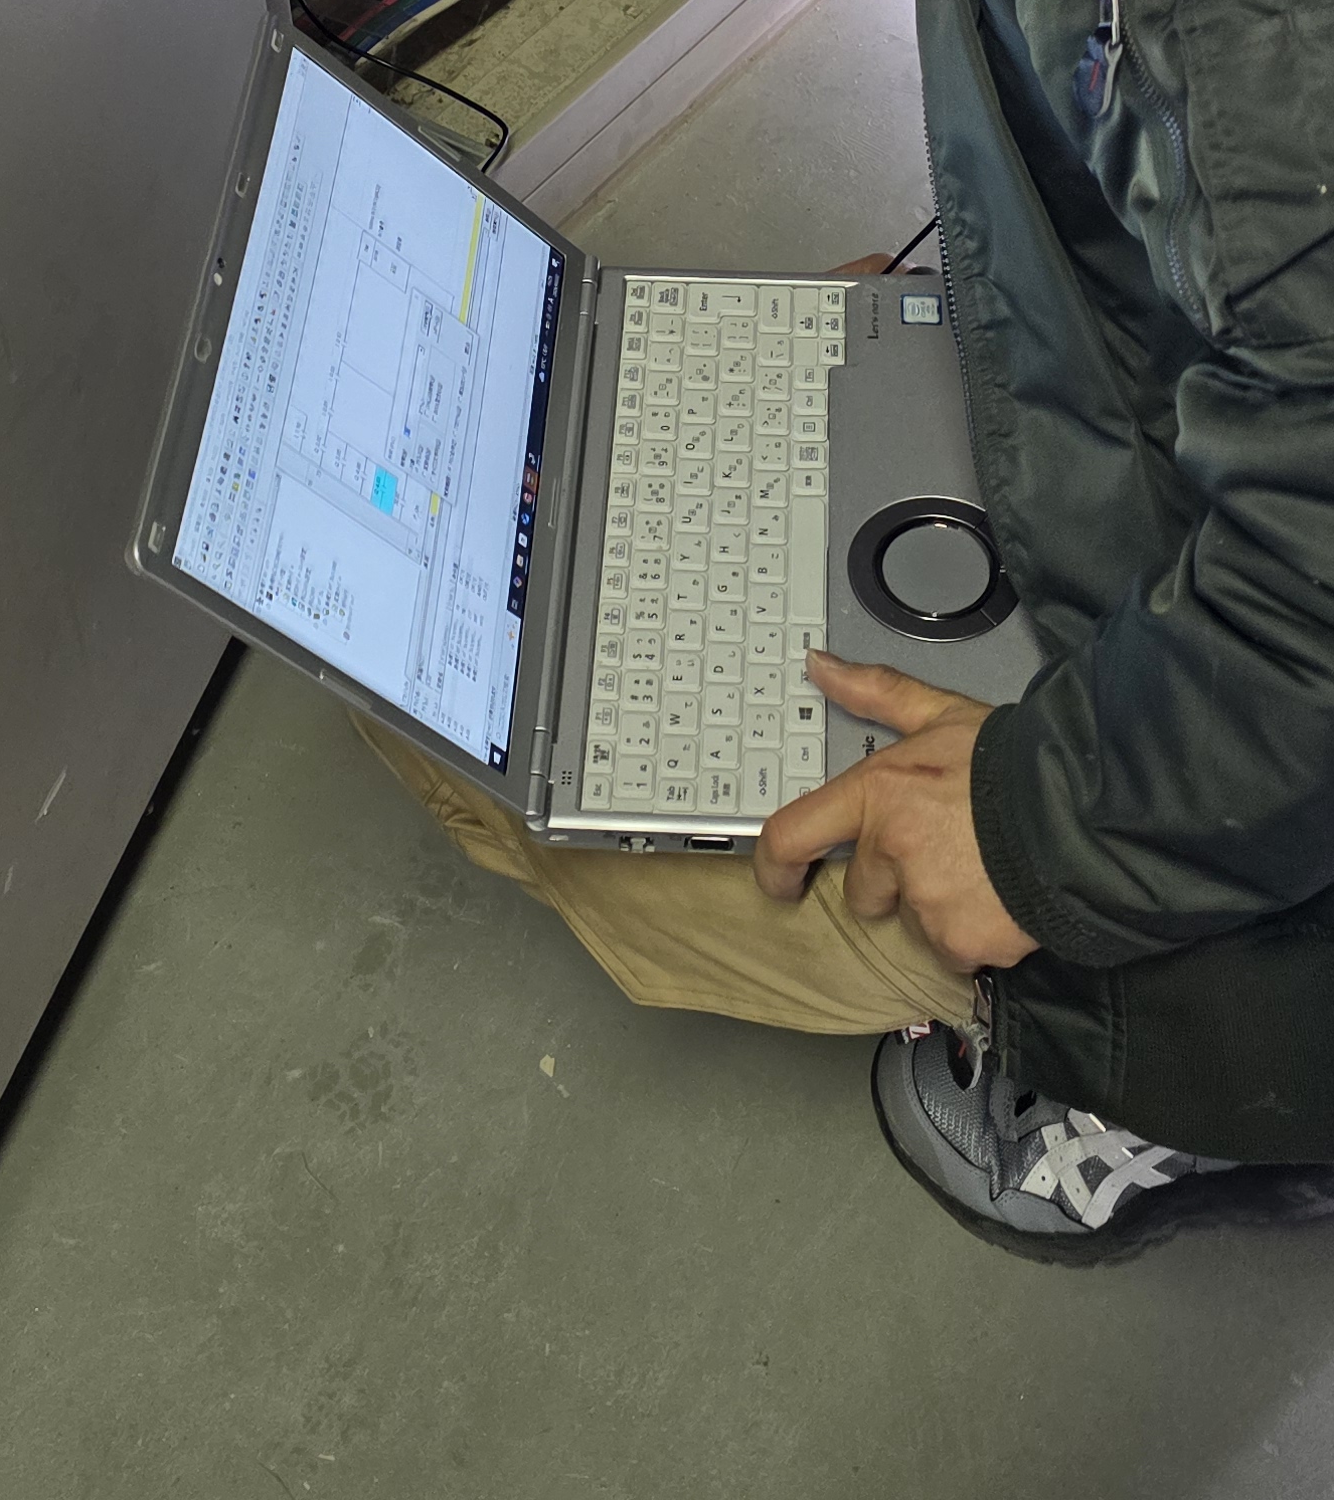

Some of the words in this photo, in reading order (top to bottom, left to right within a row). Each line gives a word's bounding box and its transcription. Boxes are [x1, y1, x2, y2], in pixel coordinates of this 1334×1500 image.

[699, 292, 708, 311] Enter
[771, 299, 779, 313] Shift
[760, 490, 769, 498] M
[670, 713, 680, 725] W
[710, 750, 720, 759] A
[801, 747, 809, 761] Ctrl
[667, 759, 678, 768] Q
[711, 775, 719, 789] Lock
[759, 768, 767, 787] Shift
[593, 784, 602, 796] Esc
[667, 786, 675, 801] Tab
[710, 789, 720, 804] Caps
